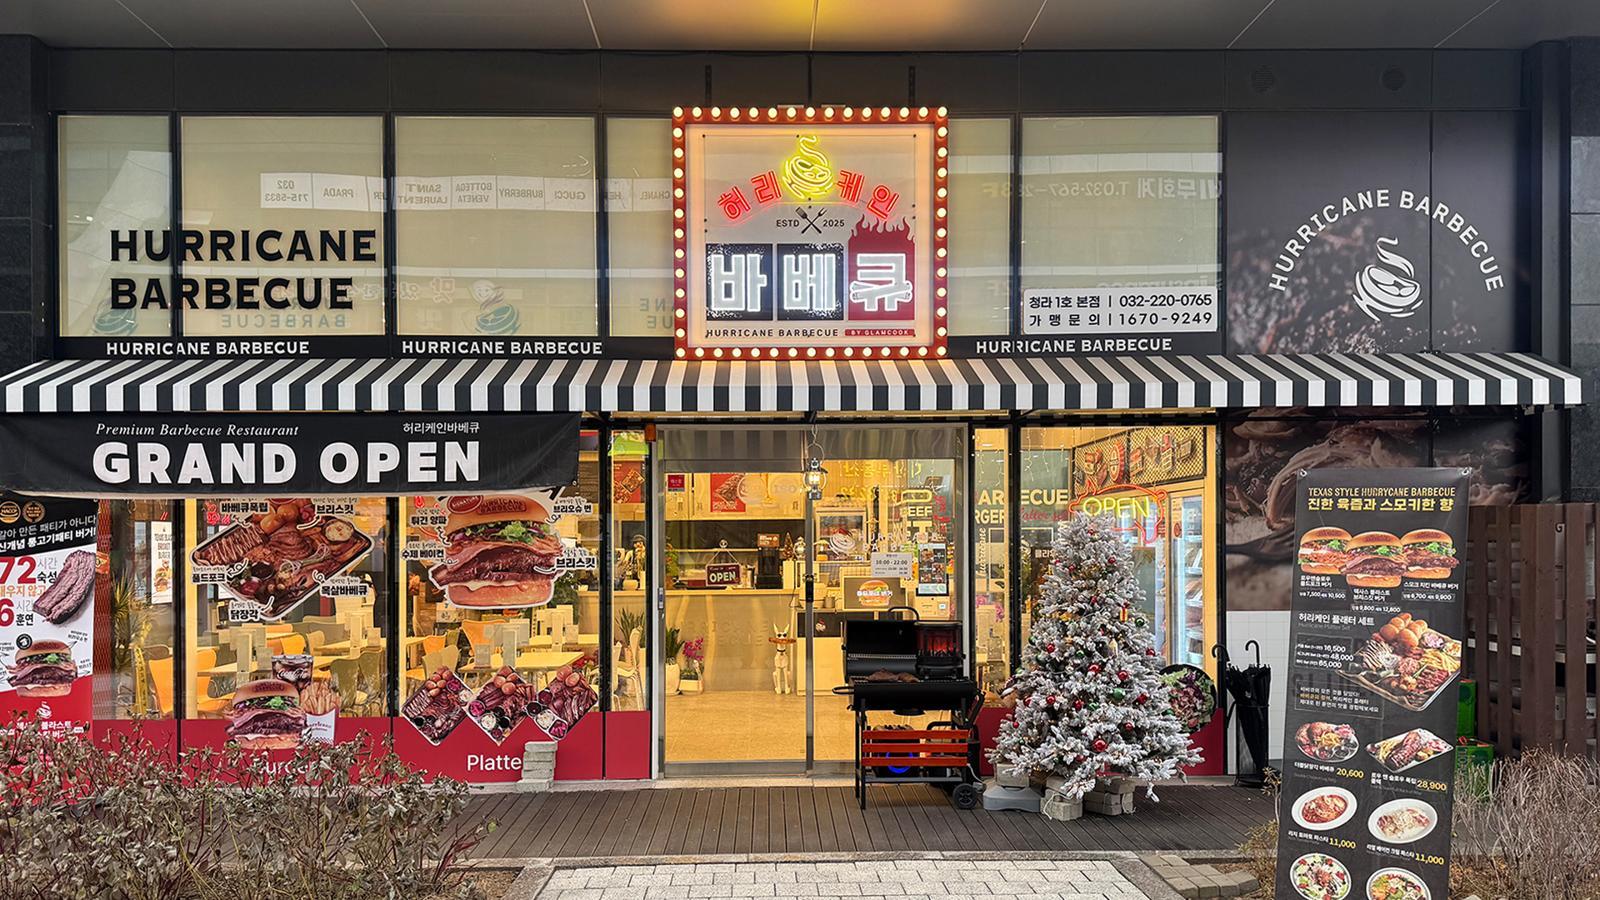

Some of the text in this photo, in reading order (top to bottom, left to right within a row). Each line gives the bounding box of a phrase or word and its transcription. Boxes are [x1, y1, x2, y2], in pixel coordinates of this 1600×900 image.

[717, 169, 900, 220] 허리케인
[775, 219, 800, 228] ESTD
[822, 219, 845, 228] 2025
[109, 229, 378, 263] HURRICANE
[1268, 189, 1504, 292] HURRICANE BARBECUE
[710, 253, 913, 312] 바베큐
[110, 277, 354, 311] BARBECUE
[1028, 293, 1213, 309] 청라 1호 본점 032-220-0765
[1119, 313, 1213, 325] 1670-9249
[705, 329, 839, 338] HURRICANE BARBECUE
[105, 340, 310, 357] HURRICANE BARBECUE
[401, 340, 603, 356] HURRICANE BARBECUE
[975, 338, 1173, 354] HURRICANE BARBECUE
[95, 423, 300, 437] Premium Barbecue Restaurant
[402, 421, 481, 435] 허리케인바베큐
[92, 440, 480, 485] GRAND OPEN
[1308, 487, 1333, 497] TEXAS
[1334, 487, 1360, 497] STYLE
[1411, 487, 1456, 497] BARBECUE
[316, 503, 354, 515] 브리스킷
[1082, 496, 1150, 519] OPEN
[1308, 498, 1454, 512] 진한 육즙과 스모키한 향
[19, 524, 38, 537] 만든
[40, 520, 68, 533] 패티가
[70, 514, 97, 528] 아니다
[0, 555, 37, 585] 72
[37, 557, 58, 570] 시간
[556, 557, 596, 569] 브리스킷
[37, 571, 58, 584] 숙성
[709, 571, 737, 583] OPEN
[0, 598, 15, 627] 6
[230, 608, 259, 620] 닭장각
[1298, 612, 1375, 626] 허리케인 플래터 세트
[16, 613, 35, 627] 훈연
[1319, 660, 1342, 669] 65,000
[1330, 653, 1354, 662] 48,000
[467, 754, 522, 771] Platte
[1336, 767, 1365, 779] 20,600
[1416, 779, 1447, 792] 28,900
[1328, 837, 1357, 849] 11,000
[1415, 852, 1445, 865] 11,000
